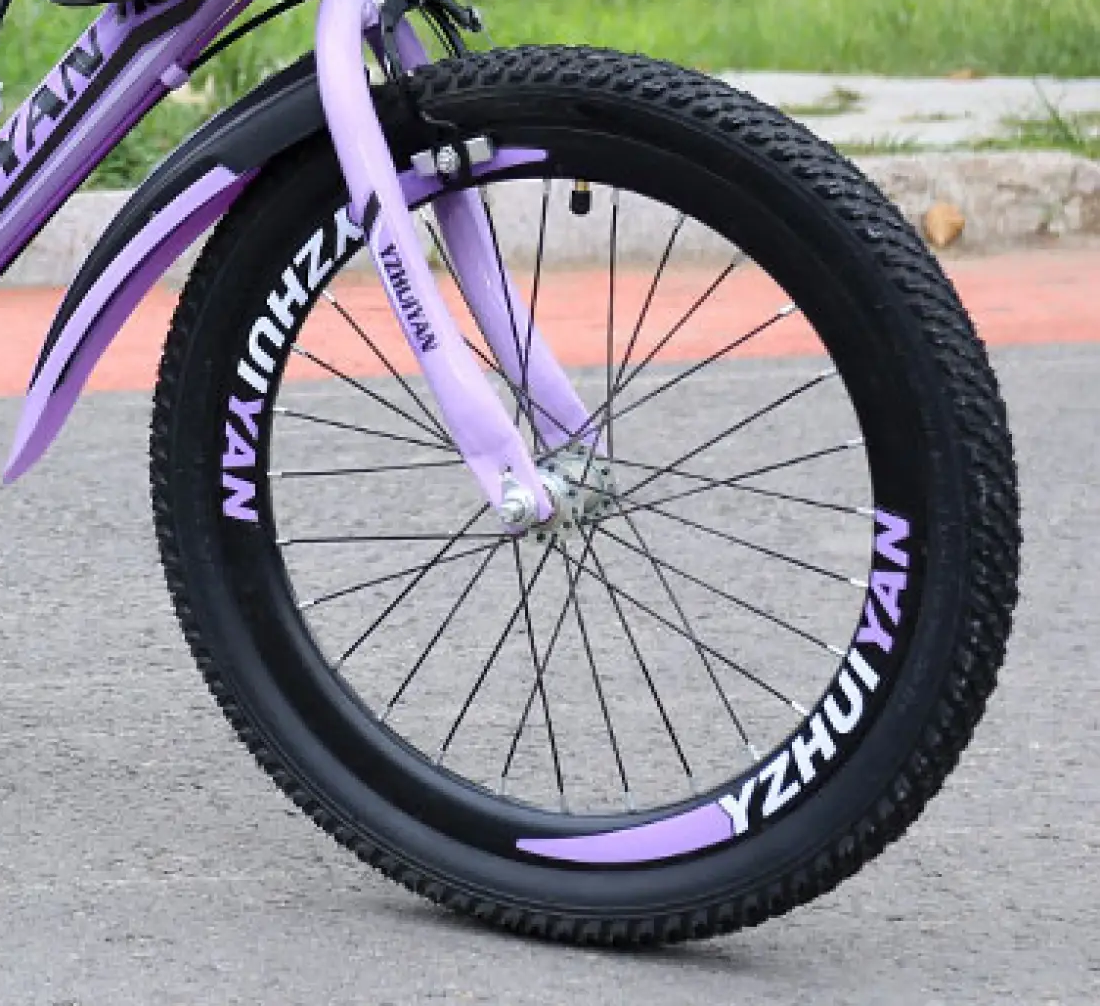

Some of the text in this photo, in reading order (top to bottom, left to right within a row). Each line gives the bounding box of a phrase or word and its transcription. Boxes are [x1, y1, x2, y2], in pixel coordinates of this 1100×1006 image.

[221, 204, 365, 523] YZHUIYAN
[377, 242, 438, 353] YZHUIYAN
[718, 507, 911, 836] YZHUIYAN
